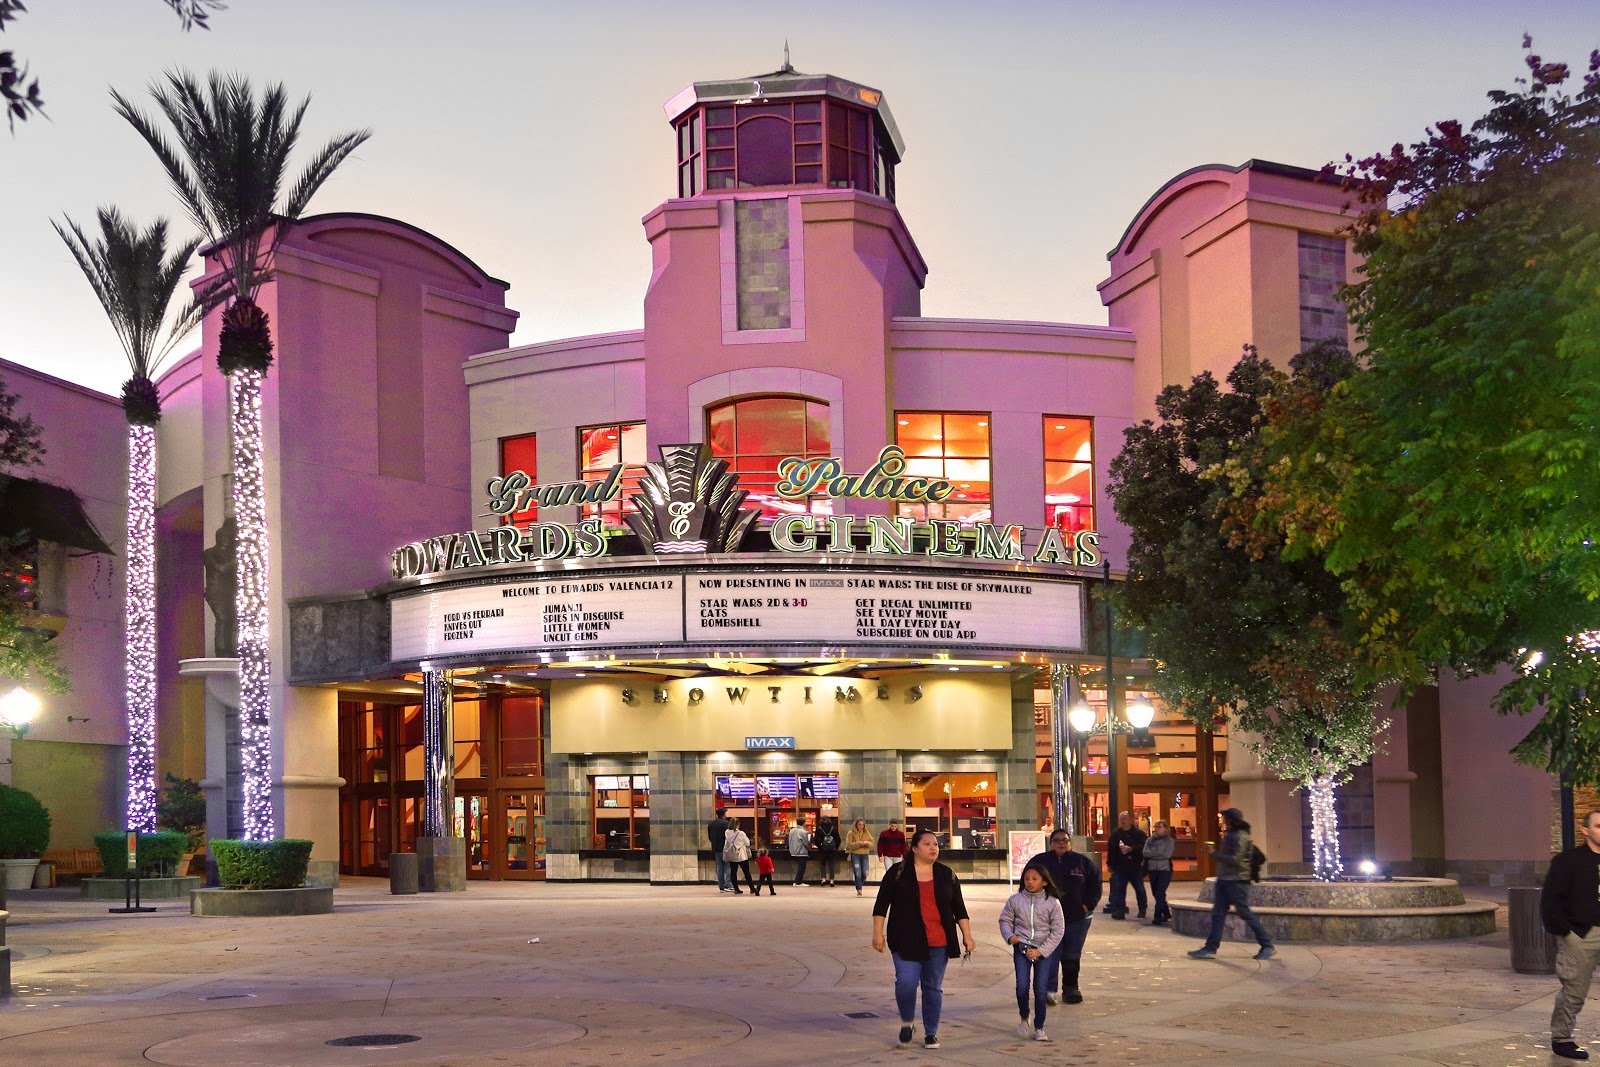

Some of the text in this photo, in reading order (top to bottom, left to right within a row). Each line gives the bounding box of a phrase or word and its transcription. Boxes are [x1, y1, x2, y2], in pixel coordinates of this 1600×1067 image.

[775, 444, 957, 501] Palace
[486, 463, 624, 514] Grand
[770, 514, 1101, 566] CINEMAS
[502, 587, 540, 598] WELCOME
[545, 586, 557, 595] TO
[561, 583, 604, 594] EDWARDS
[699, 579, 1032, 595] NOW PRESENTING IN IMAX STAR WARS: THE RISE OF SKYWALKER
[700, 598, 808, 608] STAR WARS 2D & 3-D
[856, 599, 972, 611] GET REGAL UNLIMITED
[444, 608, 504, 622] FORD VS FERRARI
[543, 611, 625, 623] SPIES IN DISGUISE
[700, 608, 728, 618] CATS
[856, 609, 948, 619] SEE EVERY MOVIE
[444, 620, 482, 632] KNIVES OUT
[543, 622, 610, 633] LITTLE WOMEN
[701, 618, 762, 627] BOMBSHELL
[856, 619, 961, 629] ALL DAY EVERY DAY
[444, 630, 474, 641] FROZEN 2
[543, 632, 598, 642] UNCUT GEMS
[856, 628, 977, 639] SUBSCRIBE ON OUR APP
[622, 685, 923, 703] SHOWTIMES
[746, 738, 793, 748] IMAX
